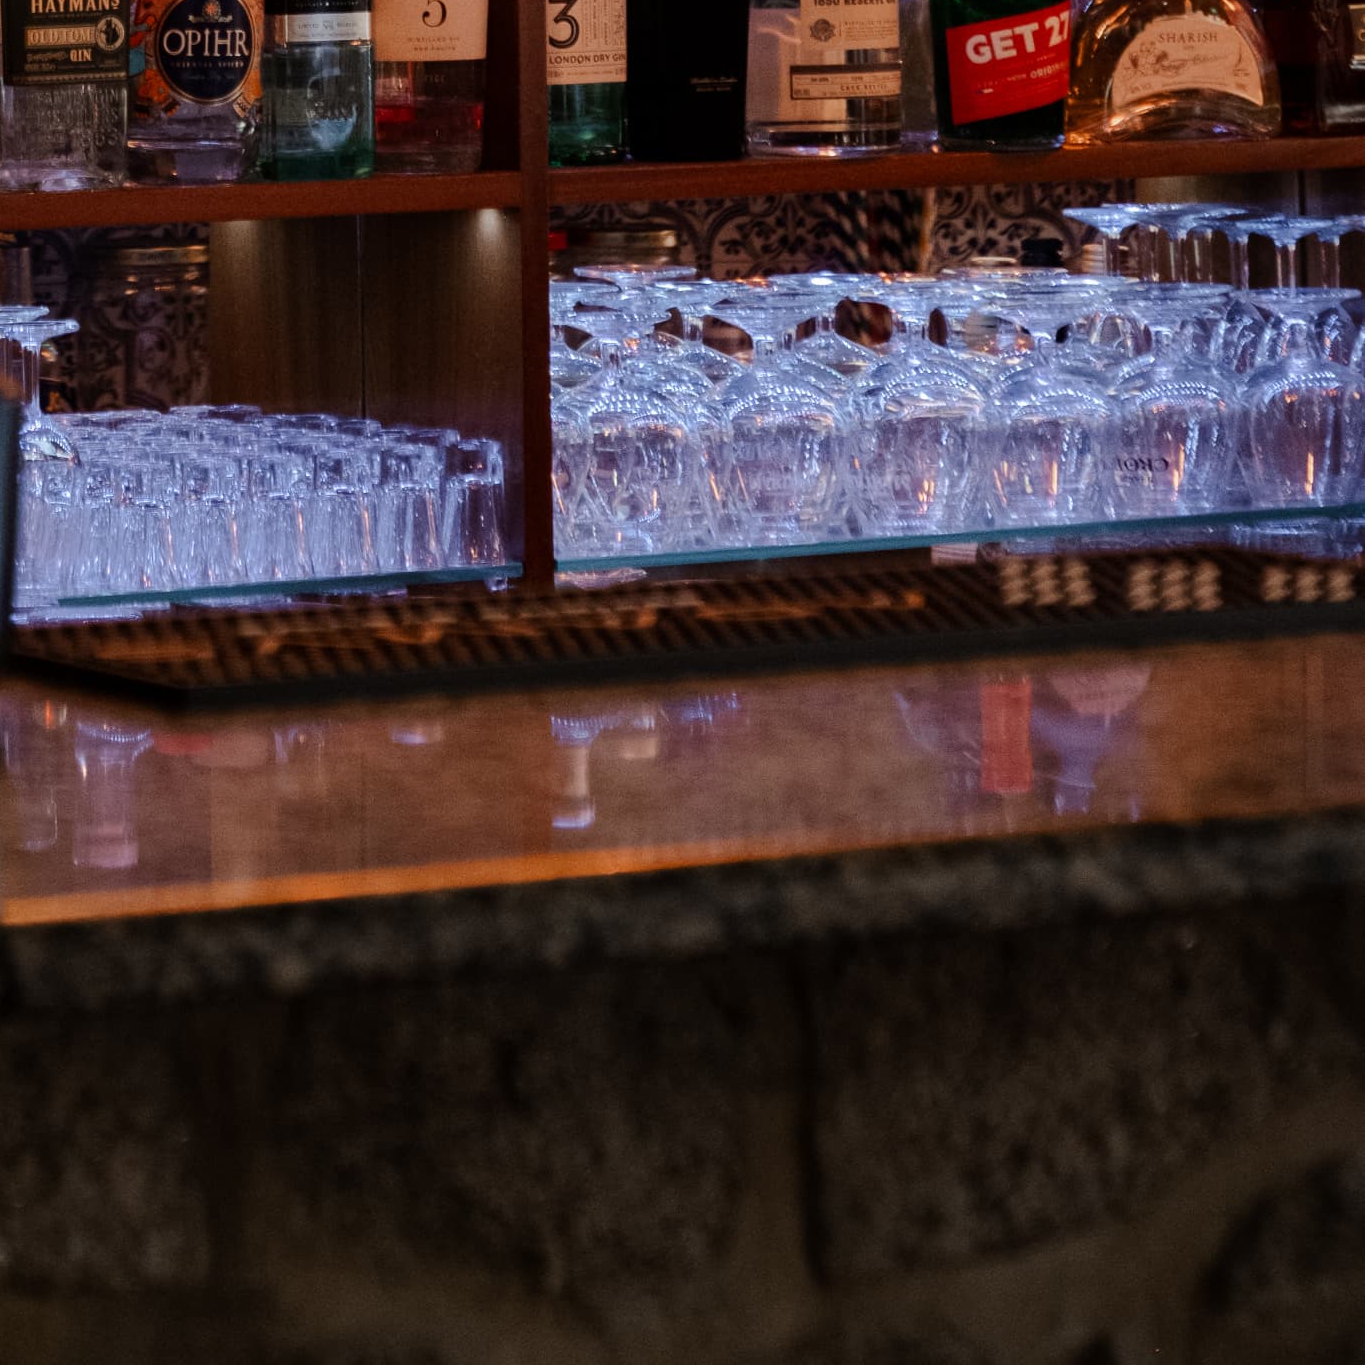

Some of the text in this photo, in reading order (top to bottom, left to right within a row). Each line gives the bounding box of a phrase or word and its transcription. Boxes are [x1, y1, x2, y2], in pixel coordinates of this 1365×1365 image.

[162, 28, 250, 57] OPIHR
[966, 10, 1071, 65] GET 27
[1158, 32, 1218, 43] SHARISH
[70, 49, 92, 62] GIN
[549, 55, 591, 65] LONDON
[593, 54, 610, 63] DRY
